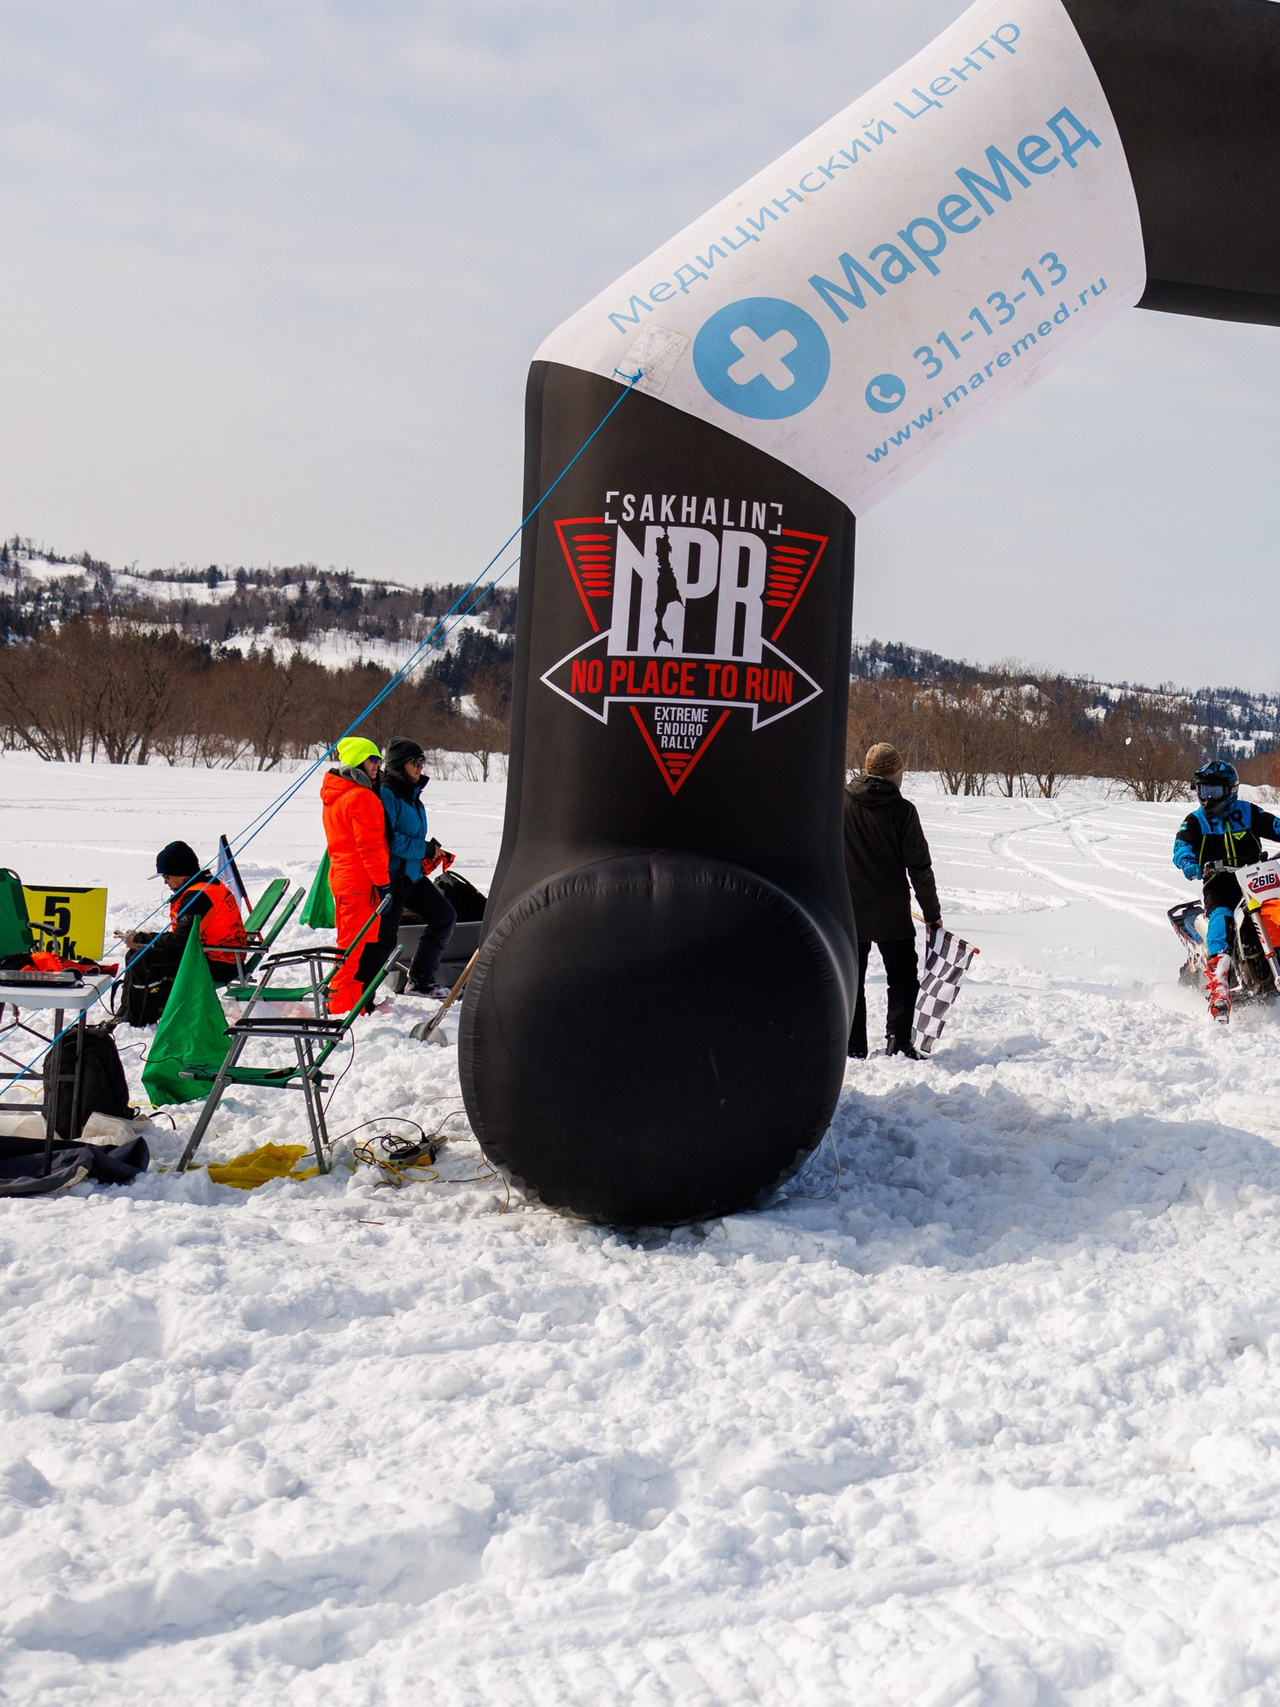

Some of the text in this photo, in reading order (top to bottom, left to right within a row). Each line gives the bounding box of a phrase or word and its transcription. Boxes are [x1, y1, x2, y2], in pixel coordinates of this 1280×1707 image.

[607, 22, 1021, 334] Медицинский Центр
[807, 106, 1102, 324] МареМед
[912, 251, 1068, 380] 31-13-13
[865, 277, 1108, 465] www.maremed.ru
[621, 493, 767, 531] SAKHALIN
[607, 523, 768, 664] NPR
[570, 659, 794, 704] NO PLACE TO RUN
[653, 706, 709, 724] EXTREME
[656, 722, 704, 737] ENDURO
[660, 735, 698, 750] RALLY
[1252, 873, 1276, 890] 2616
[43, 895, 71, 938] 5
